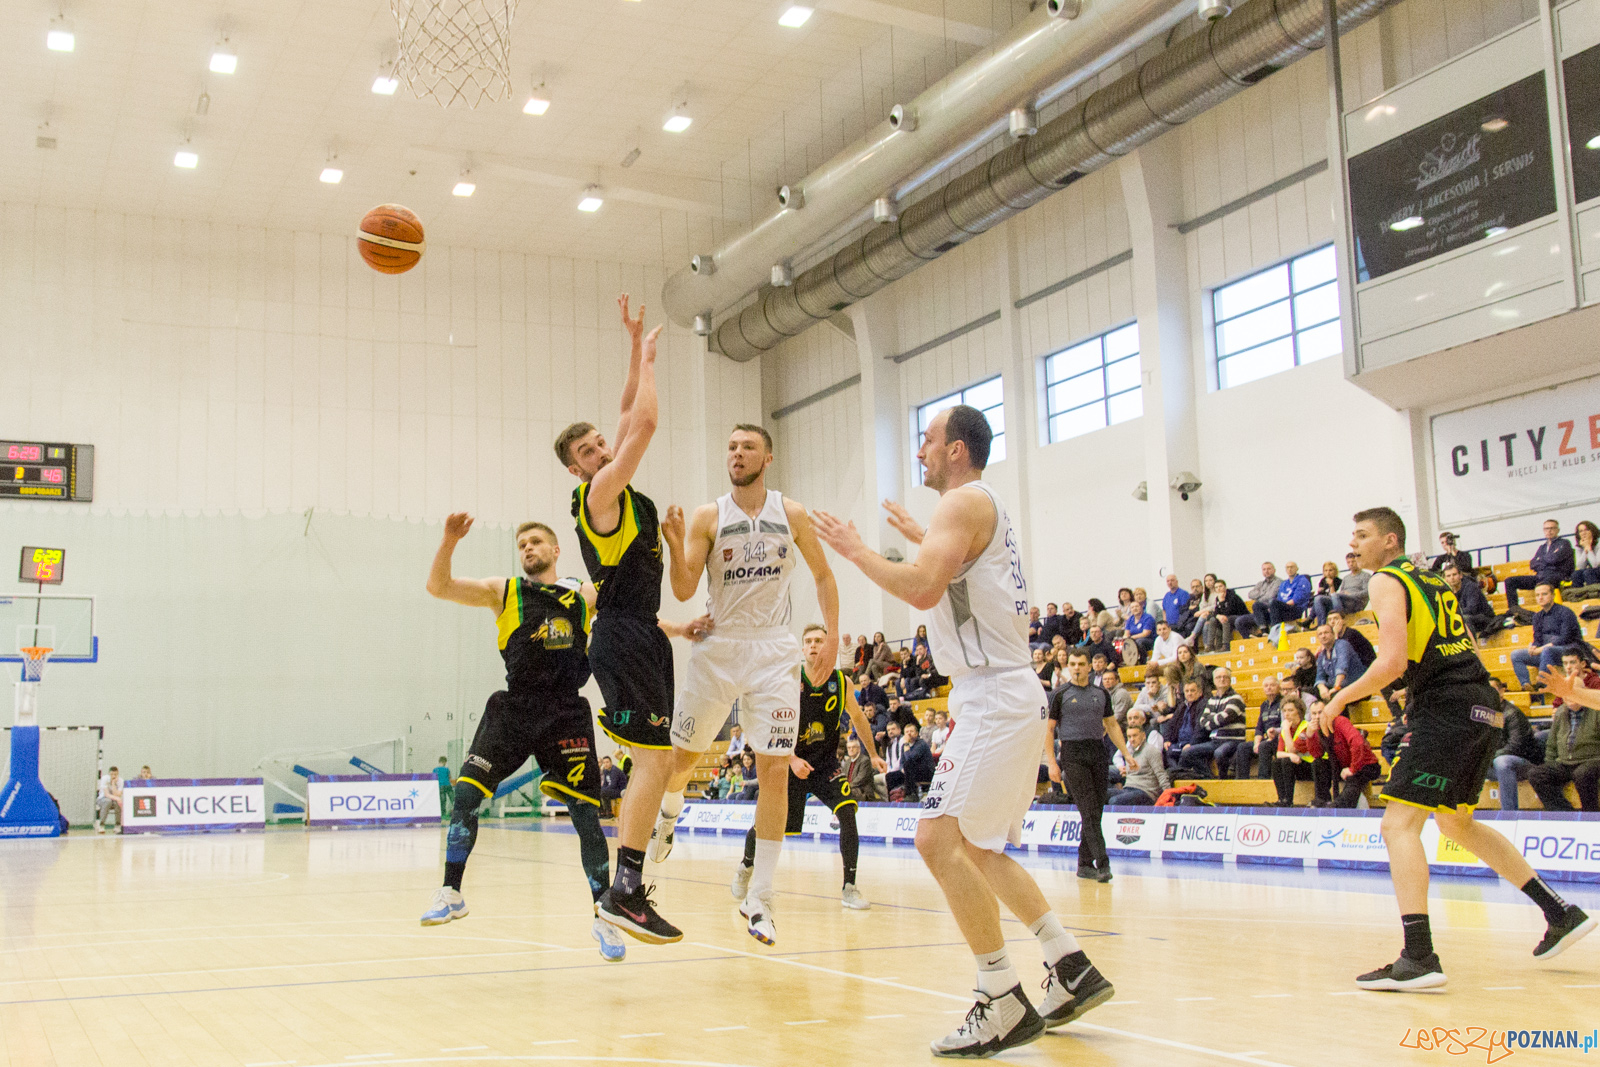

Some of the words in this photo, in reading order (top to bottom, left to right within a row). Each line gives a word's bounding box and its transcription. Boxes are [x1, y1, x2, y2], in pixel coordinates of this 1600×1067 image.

[1427, 174, 1480, 209] AKCESORIA
[1492, 151, 1534, 181] SERWIS
[1451, 413, 1600, 477] CITYZE
[1562, 455, 1586, 468] KLUB
[15, 466, 25, 479] 3
[43, 468, 62, 483] 46
[743, 541, 767, 563] 14
[36, 562, 52, 578] 15
[723, 566, 781, 580] BIOFARM
[558, 589, 576, 609] 4
[1435, 590, 1466, 638] 18
[613, 709, 636, 725] OT
[776, 710, 793, 718] KIA
[770, 726, 795, 734] DELIK
[775, 738, 793, 749] PBG
[566, 762, 586, 787] 4
[931, 781, 946, 791] LIK
[167, 795, 257, 815] NICKEL
[803, 814, 818, 826] CKEL
[1119, 825, 1140, 834] JOKER
[1181, 825, 1231, 842] NICKEL
[1242, 828, 1264, 842] KIA
[1278, 830, 1312, 844] DELIK
[1342, 828, 1384, 844] funcl
[1523, 836, 1600, 861] POZna
